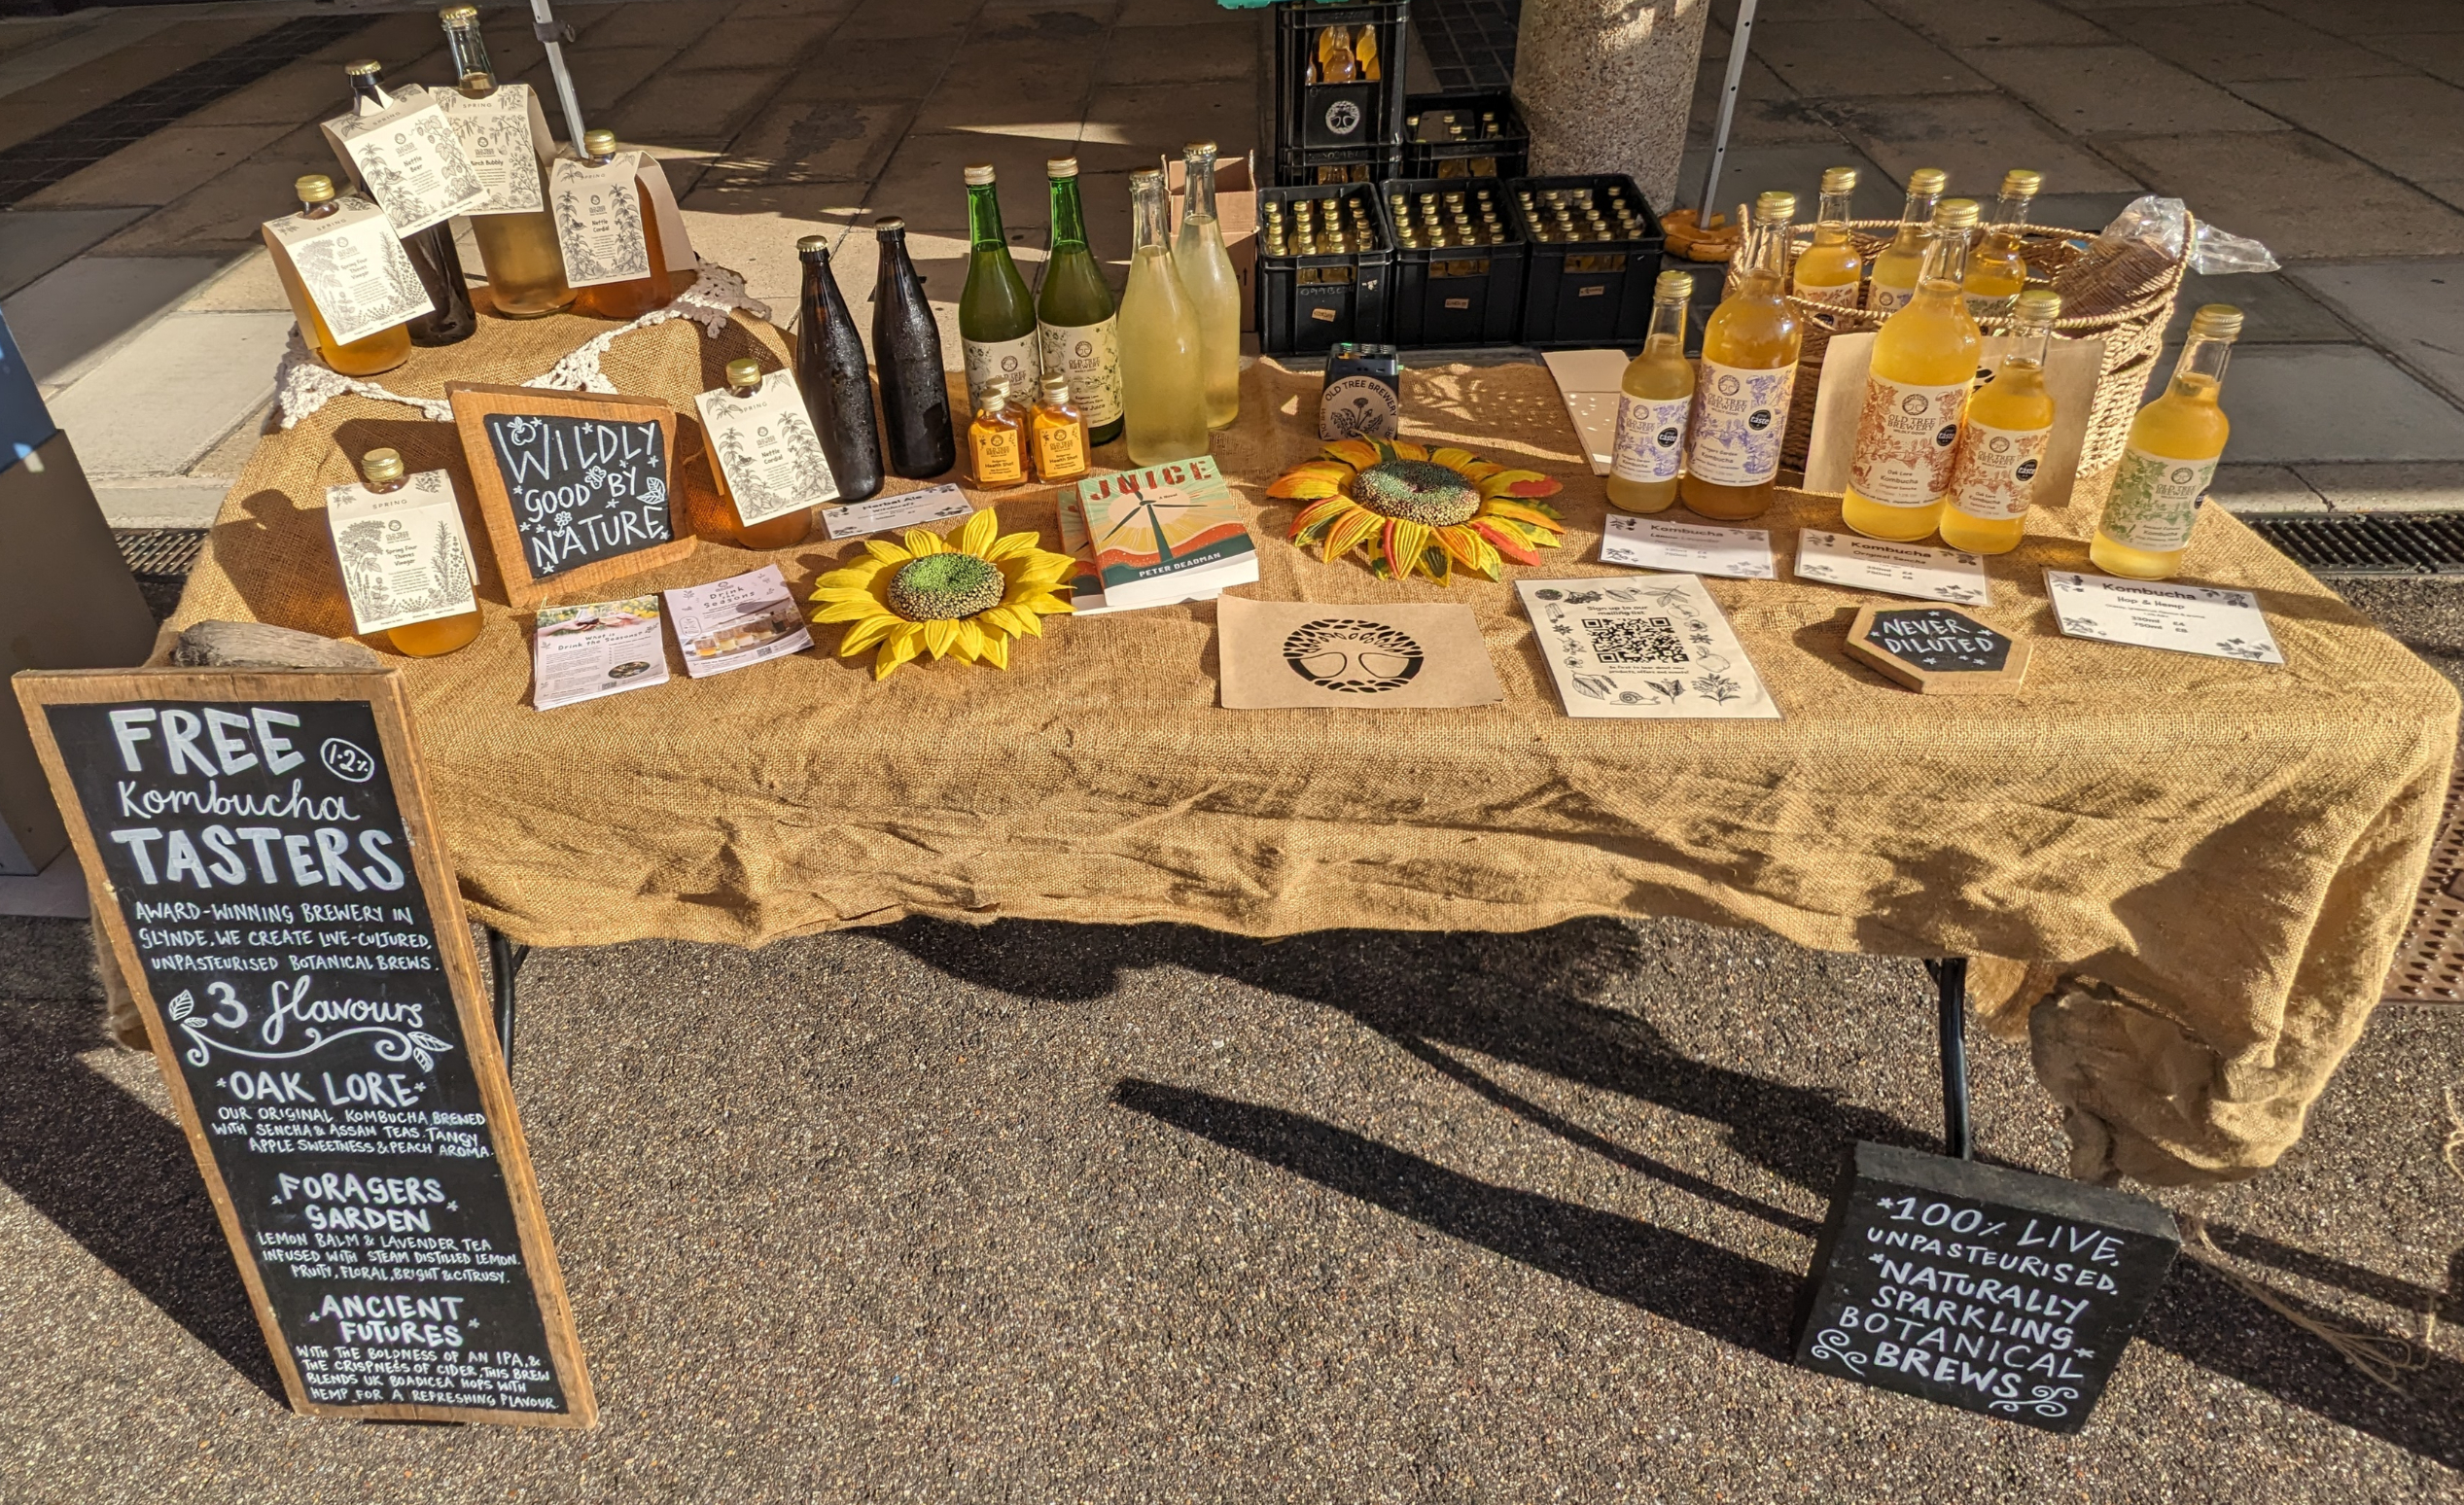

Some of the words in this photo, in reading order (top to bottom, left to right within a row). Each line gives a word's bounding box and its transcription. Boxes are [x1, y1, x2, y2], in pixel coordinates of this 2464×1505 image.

[404, 156, 422, 167] Nettle
[410, 164, 422, 172] Beer
[317, 219, 346, 231] SPRING
[1325, 385, 1341, 401] OLD
[1342, 380, 1366, 389] TREE
[1368, 382, 1397, 417] BREWERY
[1707, 393, 1723, 402] OLD
[1725, 398, 1748, 407] TREE
[1707, 401, 1746, 412] BREWERY
[1750, 416, 1770, 425] taste
[1888, 420, 1935, 431] BREWERY
[1889, 414, 1908, 423] OLD
[494, 422, 655, 483] WILDLY
[761, 448, 780, 458] Nettle
[764, 454, 783, 464] Cordial
[1701, 452, 1733, 463] Kombucha
[1977, 455, 2014, 465] BREWERY
[1090, 460, 1212, 500] JUICE
[1880, 475, 1918, 484] Kombucha
[525, 483, 590, 523] GOOD
[608, 466, 636, 498] BY
[1969, 495, 2000, 504] Kombucha
[372, 499, 407, 509] SPRING
[862, 500, 901, 510] Herbal
[532, 506, 664, 567] NATURE
[1651, 525, 1724, 537] Kombucha
[385, 547, 404, 555] Spring
[1851, 542, 1932, 558] Kombucha
[1853, 550, 1890, 559] Original
[1139, 564, 1172, 578] PETER
[1174, 552, 1221, 570] DEADMAN
[704, 591, 755, 608] Seasons
[709, 587, 744, 600] Drink
[2102, 583, 2196, 600] Kombucha
[2154, 601, 2185, 610] Hemp
[1882, 617, 1970, 638] NEVER
[605, 631, 642, 642] Seasons?
[1884, 637, 1994, 654] DILUTED
[109, 708, 305, 777] FREE
[118, 779, 361, 821] Kombucha
[111, 825, 405, 891] TASTERS
[136, 902, 293, 924] AWARD-WINNING
[301, 903, 383, 923] BREWERY
[393, 906, 413, 925] IN
[218, 929, 241, 946] WE
[248, 929, 313, 947] CREATE
[319, 931, 433, 950] LIVE-CULTURED,
[151, 957, 278, 971] UNPASTEURISED
[289, 955, 373, 971] BOTANICAL
[378, 956, 440, 971] BREWS.
[207, 981, 249, 1028] 3
[261, 975, 423, 1045] flavours
[229, 1070, 315, 1103] OAK
[322, 1072, 418, 1107] LORE
[218, 1107, 252, 1120] OUR
[258, 1107, 334, 1124] ORIGINAL
[212, 1122, 247, 1137] WITH
[256, 1123, 310, 1137] SENCHA
[313, 1126, 325, 1136] &
[329, 1124, 377, 1138] ASSAM
[427, 1126, 478, 1147] TANGY
[248, 1138, 295, 1154] APPLE
[298, 1139, 375, 1154] SWEETNESS
[377, 1141, 390, 1154] &
[390, 1141, 432, 1154] PEACH
[278, 1172, 446, 1205] FORAGERS
[305, 1204, 431, 1233] GARDEN
[257, 1232, 308, 1247] LEMON
[315, 1233, 359, 1247] BALM
[363, 1235, 375, 1246] &
[380, 1235, 459, 1252] LAVENDER
[461, 1238, 492, 1251] TEA
[2017, 1219, 2124, 1266] LIVE,
[263, 1249, 320, 1262] INFUSED
[326, 1250, 357, 1263] WITH
[368, 1250, 409, 1263] STEAM
[414, 1251, 472, 1264] DISTILLED
[1867, 1227, 2119, 1295] UNPASTEURISED,
[394, 1267, 438, 1282] BRIGHT
[442, 1269, 453, 1281] &
[321, 1294, 464, 1320] ANCIENT
[340, 1321, 463, 1347] FUTURES
[1839, 1306, 2084, 1380] BOTANICAL
[296, 1345, 328, 1358] WITH
[334, 1346, 360, 1359] THE
[368, 1347, 437, 1362] BOLDNESS
[444, 1351, 459, 1362] OF
[468, 1351, 488, 1363] AN
[303, 1359, 327, 1371] THE
[334, 1359, 410, 1373] CRISPNESS
[414, 1362, 430, 1374] OF
[482, 1365, 509, 1380] THIS
[512, 1369, 550, 1381] BREW
[1874, 1342, 2022, 1399] BREWS
[307, 1373, 358, 1386] BLENDS
[364, 1375, 381, 1387] UK
[390, 1375, 455, 1388] BOADICEA
[461, 1378, 493, 1391] HOPS
[497, 1379, 526, 1393] WITH
[311, 1387, 348, 1400] HEMP
[356, 1389, 383, 1400] FOR
[391, 1389, 404, 1402] A
[412, 1390, 496, 1406] REFRESHING
